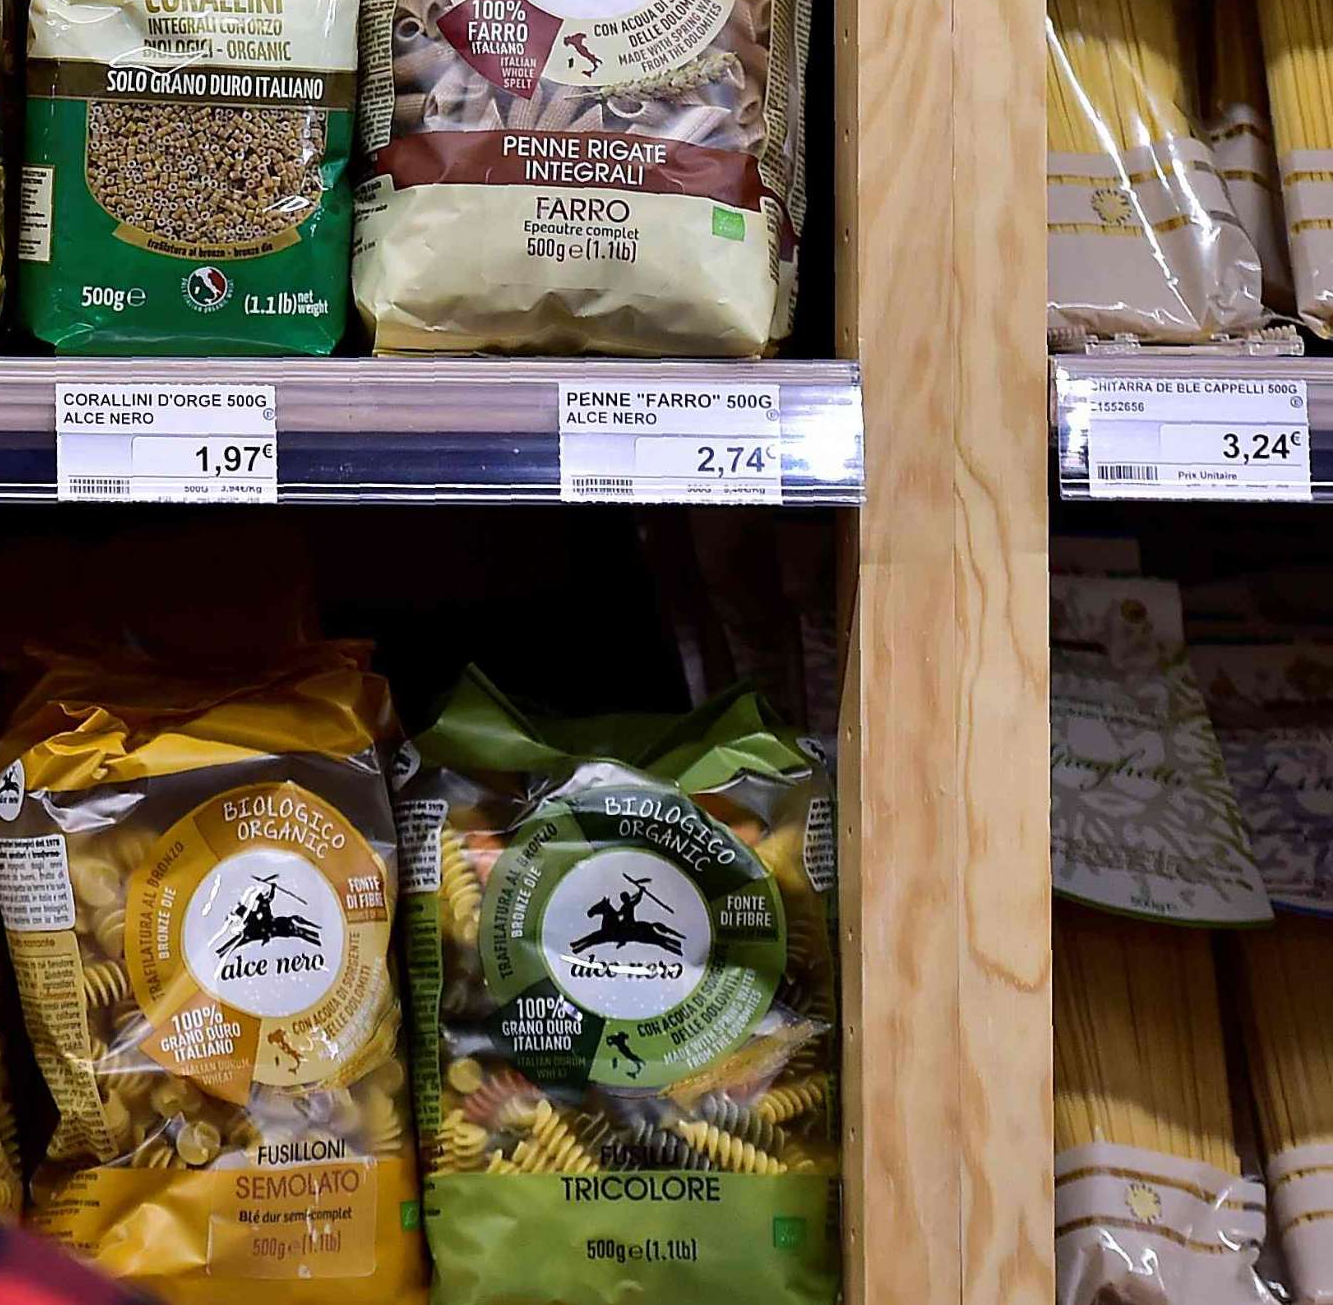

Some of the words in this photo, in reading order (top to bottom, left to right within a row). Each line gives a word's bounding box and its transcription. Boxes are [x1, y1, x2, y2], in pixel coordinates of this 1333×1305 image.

[472, 0, 526, 21] 100%
[468, 22, 529, 42] FARRO
[106, 70, 146, 92] SOLO
[151, 72, 207, 95] GRANO
[211, 74, 251, 96] DURO
[255, 76, 323, 100] ITALIANO
[503, 135, 580, 159] PENNE
[592, 139, 667, 165] RIGATE
[525, 159, 645, 186] INTEGRALI
[536, 196, 630, 223] FARRO
[524, 220, 583, 237] Epeautre
[586, 223, 640, 241] complet
[63, 393, 152, 407] CORALLINI
[158, 393, 221, 407] D'ORGE
[567, 392, 631, 407] PENNE
[637, 393, 720, 408] "FARRO"
[727, 395, 772, 408] 500G
[1156, 383, 1173, 393] DE
[1177, 383, 1200, 393] BLE
[1204, 384, 1264, 394] CAPPELLI
[567, 412, 607, 424] ALCE
[613, 413, 657, 425] NERO
[223, 795, 346, 851] BIOLOGICO
[605, 796, 736, 865] BIOLOGICO
[727, 895, 766, 912] FONTE
[735, 911, 772, 927] FIBRE
[171, 1004, 223, 1032] 100%
[173, 1039, 233, 1062] ITALIANO
[257, 1139, 346, 1166] FUSILLONI
[235, 1169, 360, 1200] SEMOLATO
[561, 1176, 721, 1202] TRICOLORE
